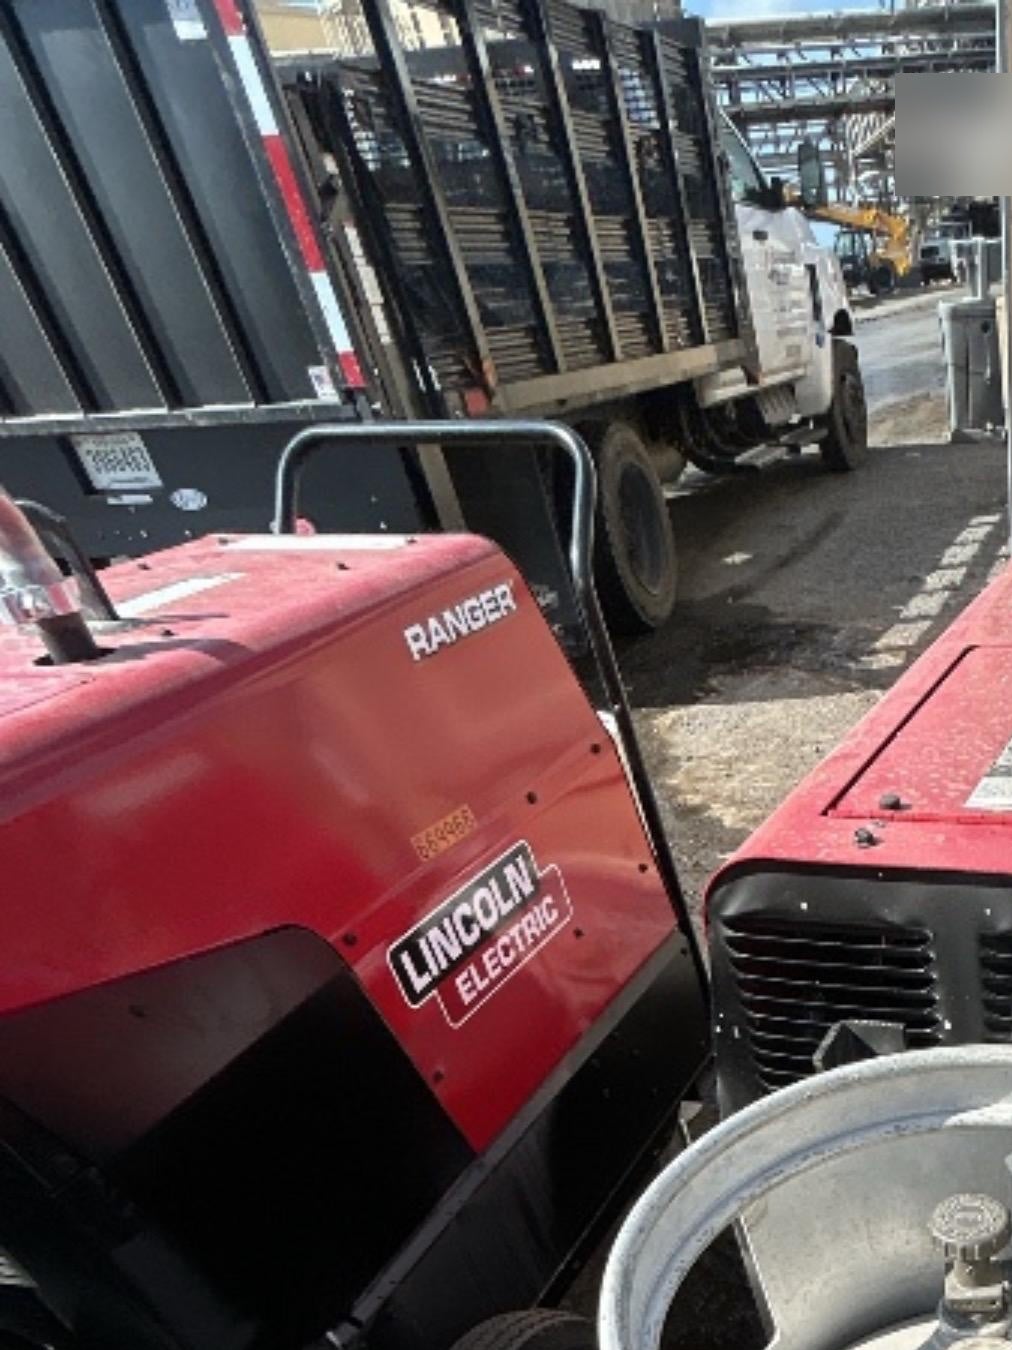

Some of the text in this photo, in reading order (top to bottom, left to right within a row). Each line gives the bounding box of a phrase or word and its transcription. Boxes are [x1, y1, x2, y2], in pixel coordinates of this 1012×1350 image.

[403, 583, 517, 661] RANGER
[400, 854, 535, 993] LINCOLN
[455, 895, 559, 1006] ELECTRIC
